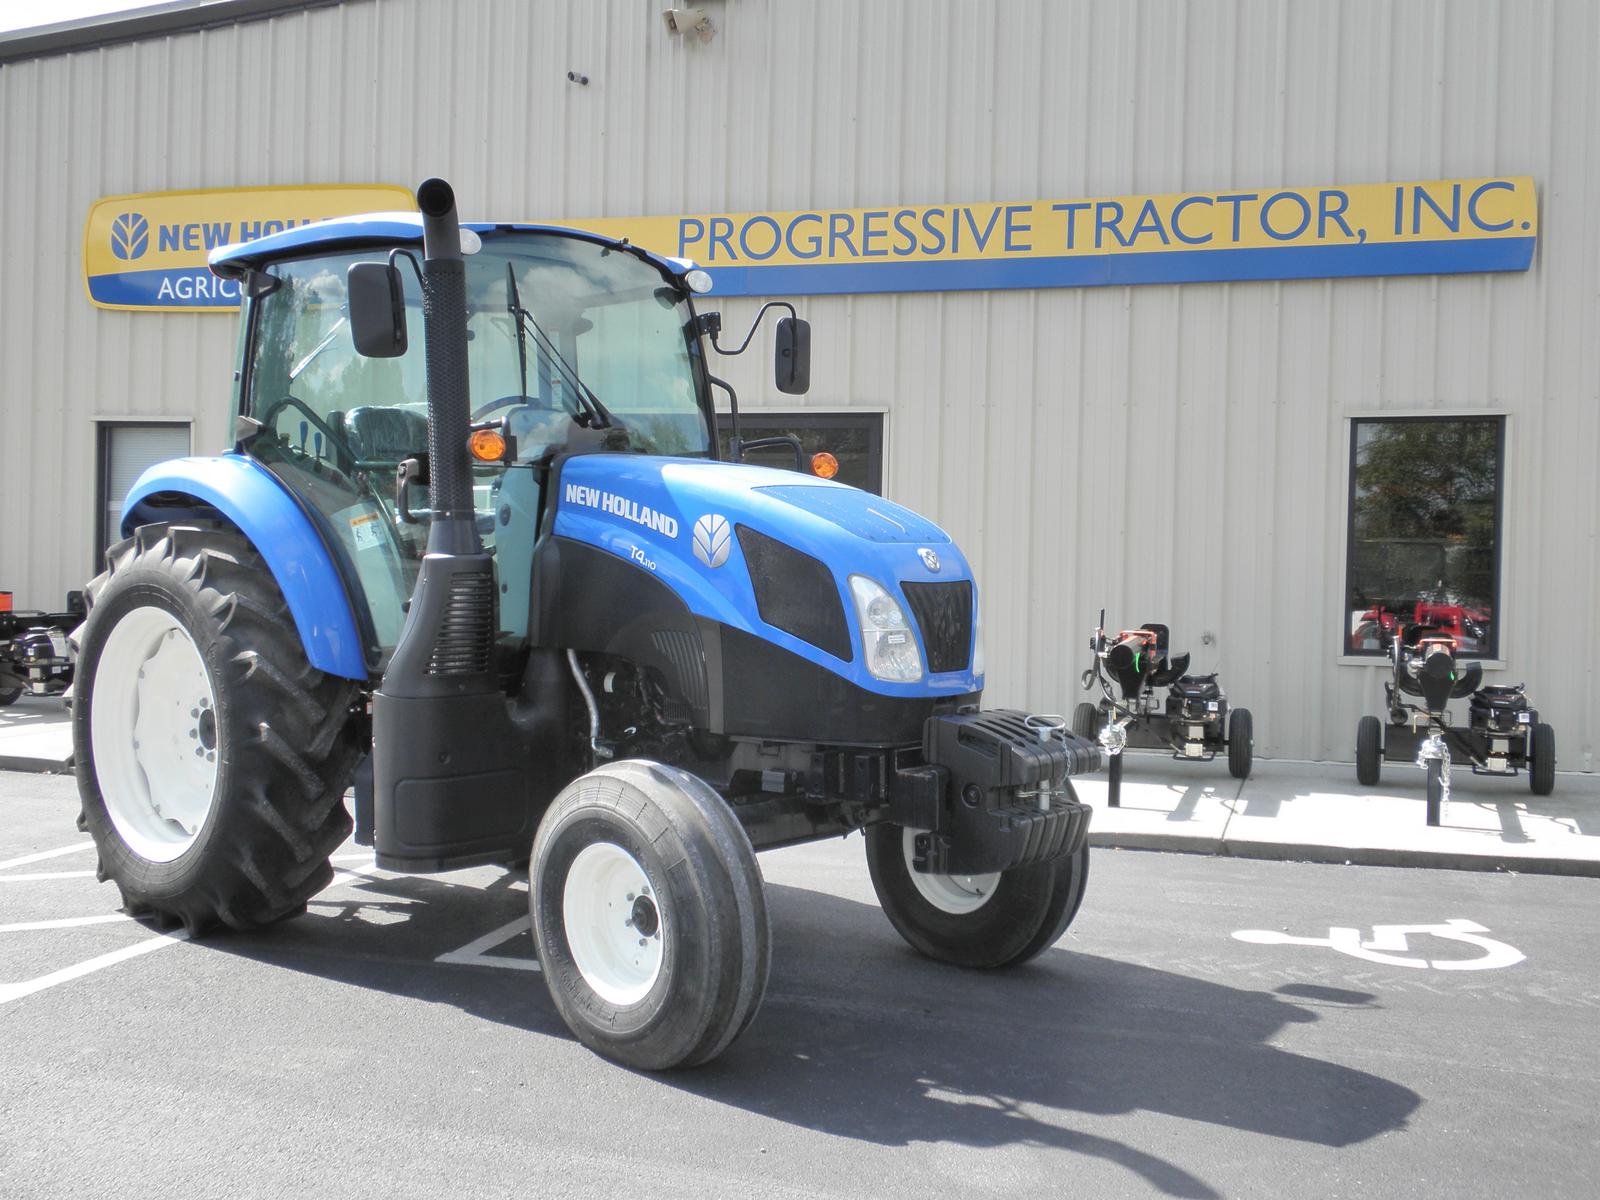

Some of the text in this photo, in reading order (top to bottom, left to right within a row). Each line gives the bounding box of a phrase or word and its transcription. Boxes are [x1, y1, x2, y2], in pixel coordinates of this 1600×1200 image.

[158, 222, 232, 252] NEW
[678, 180, 1532, 262] PROGRESSIVE TRACTOR, INC.
[565, 483, 679, 540] NEW HOLLAND
